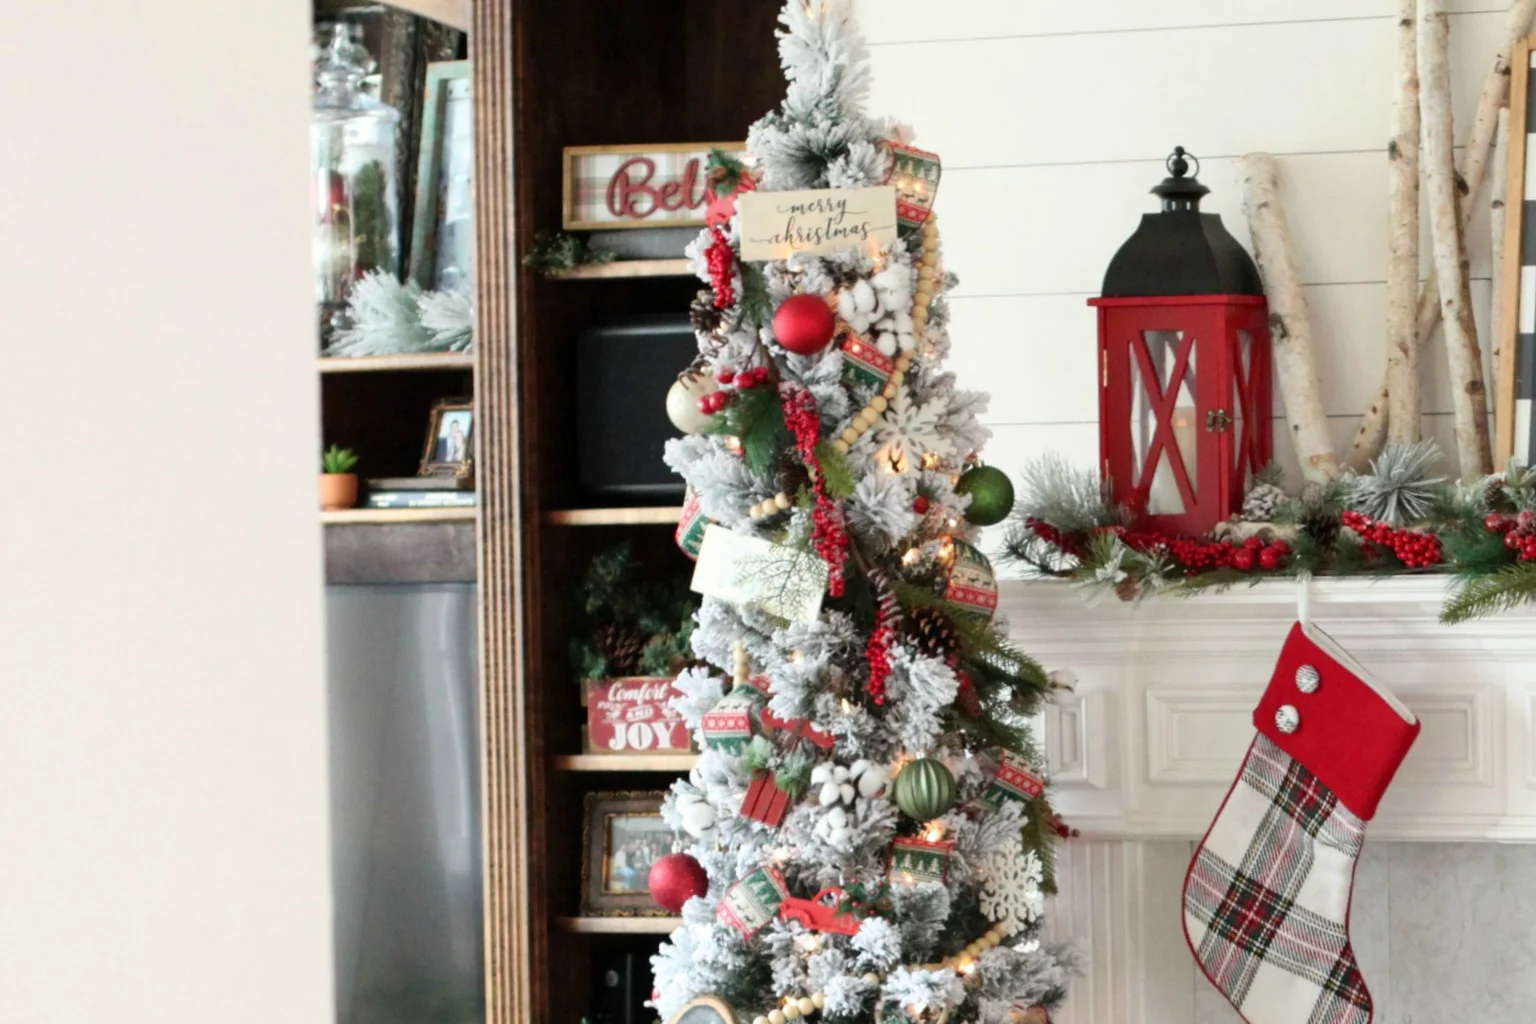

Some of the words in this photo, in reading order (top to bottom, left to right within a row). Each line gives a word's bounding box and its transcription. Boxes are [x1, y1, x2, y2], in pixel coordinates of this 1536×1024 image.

[777, 197, 868, 223] merry
[750, 219, 895, 251] christmas
[608, 682, 668, 705] Comfort
[608, 721, 677, 751] JOY
